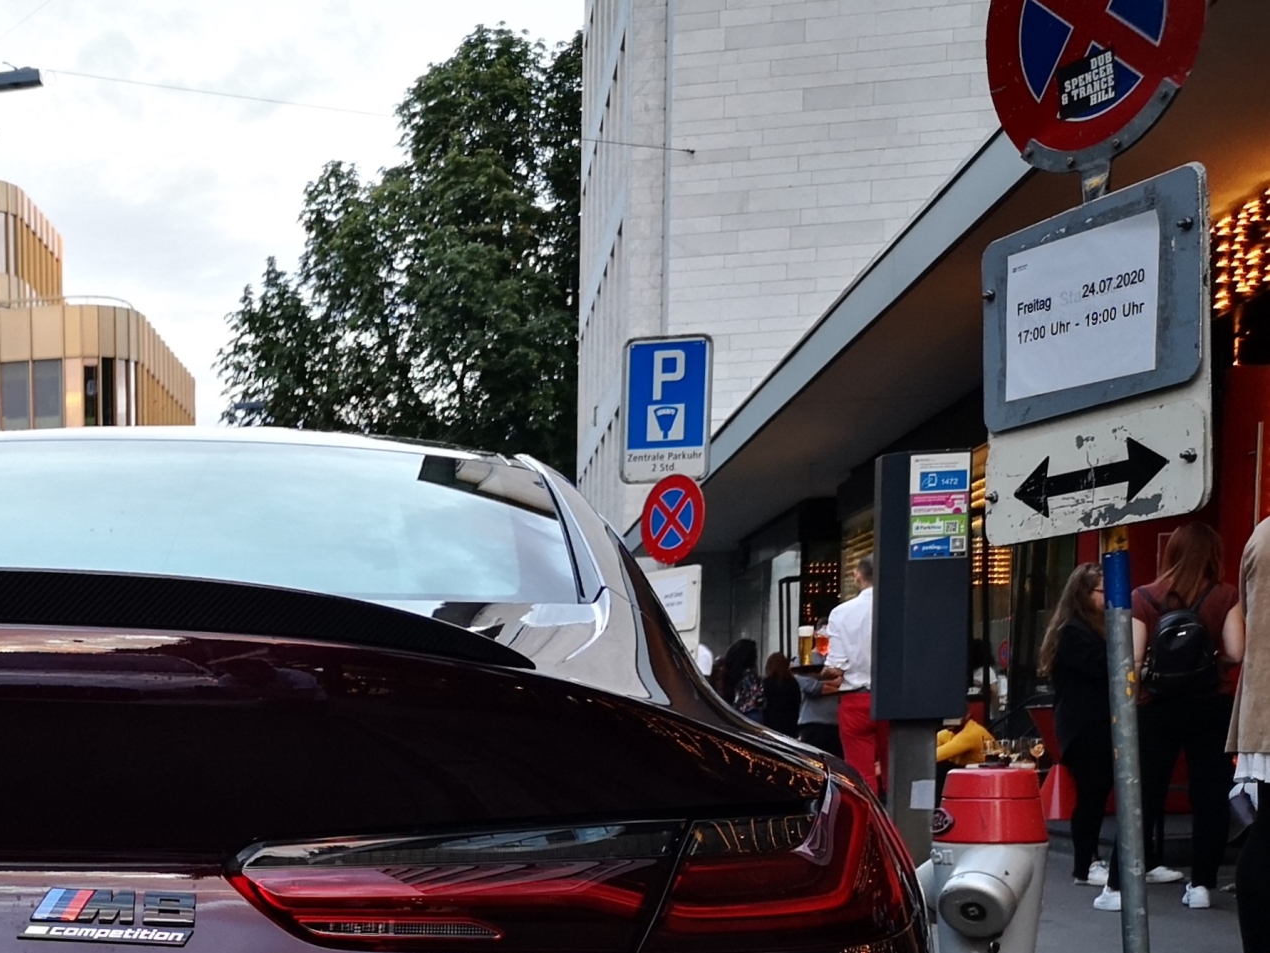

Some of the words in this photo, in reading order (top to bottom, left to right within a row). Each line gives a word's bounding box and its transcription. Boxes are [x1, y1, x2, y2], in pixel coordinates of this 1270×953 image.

[1090, 51, 1112, 70] DUB
[1064, 63, 1114, 92] SPENCER
[1071, 74, 1115, 101] TRANCE
[1089, 87, 1115, 106] HILL
[1017, 297, 1052, 316] Freitag
[1081, 268, 1146, 298] 24.07.2020
[1017, 325, 1046, 344] 17:00
[1051, 320, 1070, 336] Uhr
[1084, 306, 1117, 327] 19:00
[1122, 301, 1145, 318] Uhr
[652, 349, 686, 401] P
[627, 452, 665, 463] Zentrale
[667, 451, 703, 461] Parkuhr
[651, 463, 657, 473] 2
[941, 477, 959, 486] 1472
[49, 926, 185, 943] competition
